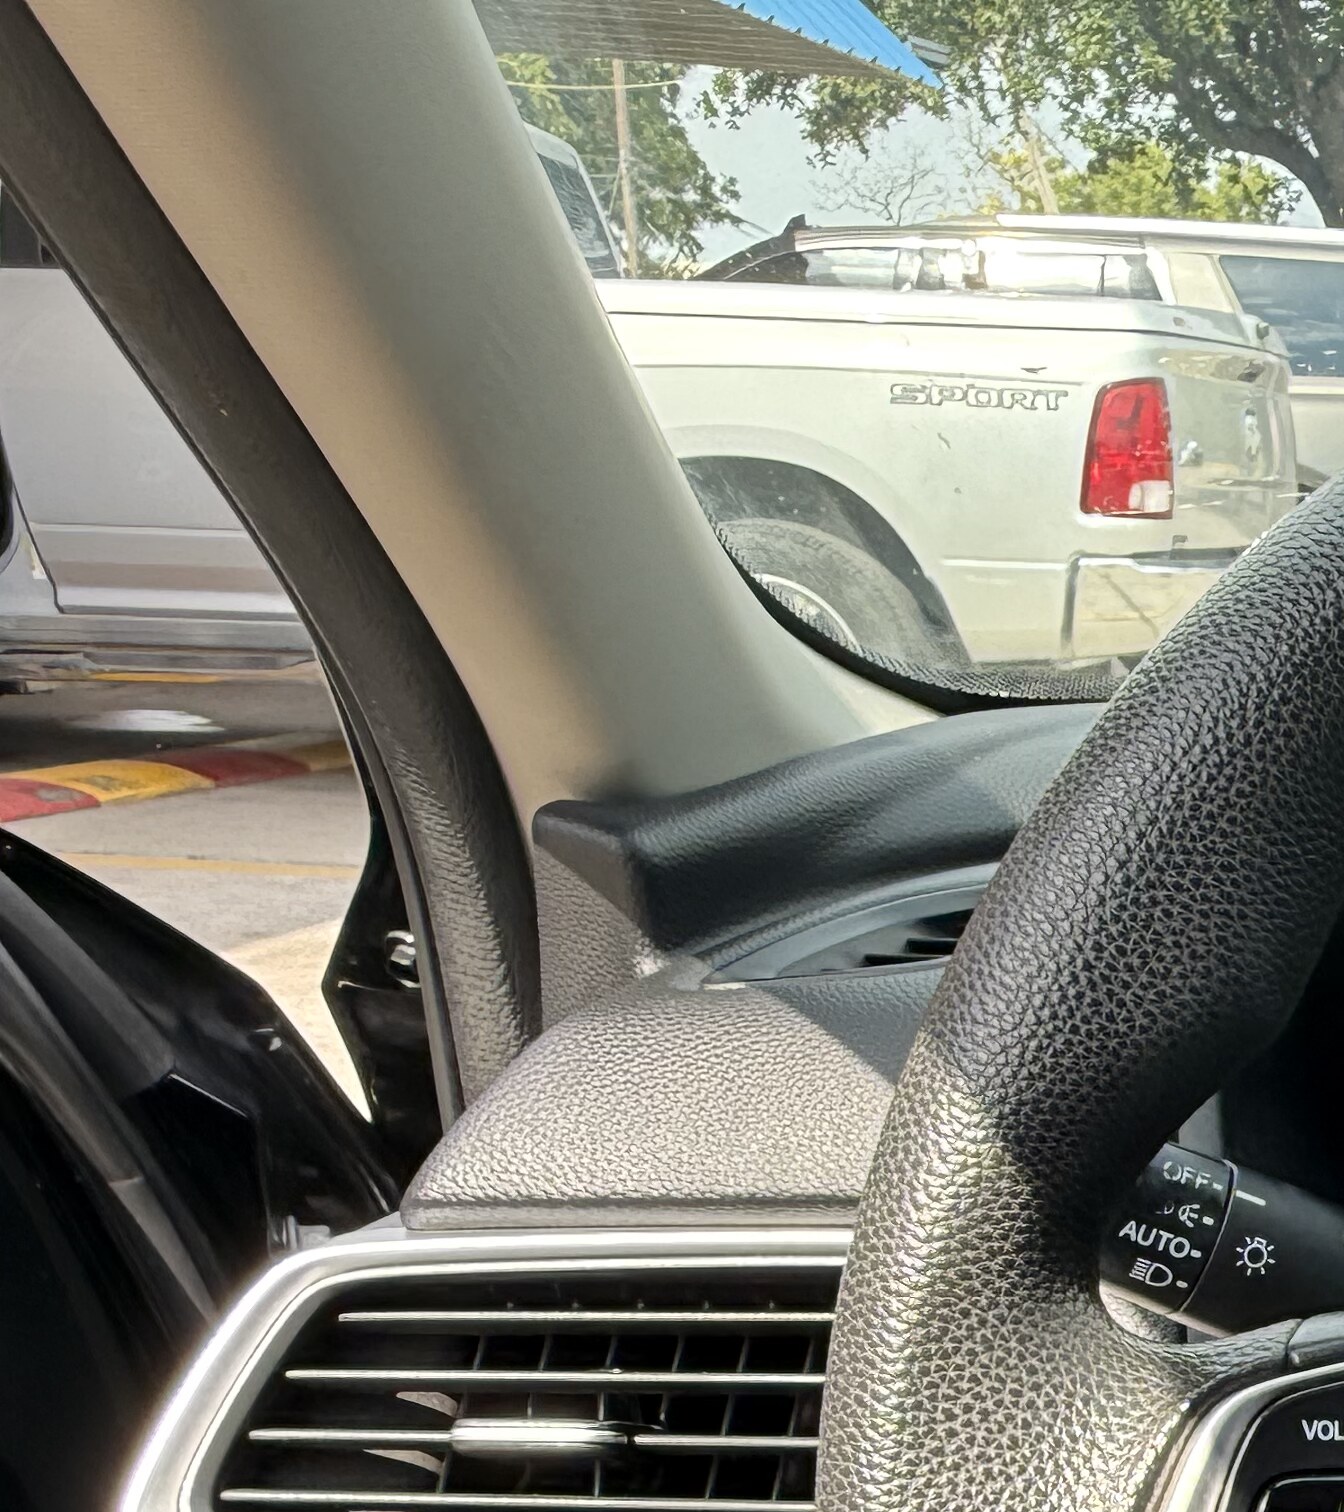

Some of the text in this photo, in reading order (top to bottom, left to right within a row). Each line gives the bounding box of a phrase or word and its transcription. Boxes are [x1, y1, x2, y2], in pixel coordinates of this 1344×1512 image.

[889, 383, 1070, 411] SPORT
[1162, 1161, 1212, 1189] OFF
[1118, 1220, 1191, 1258] AUTO
